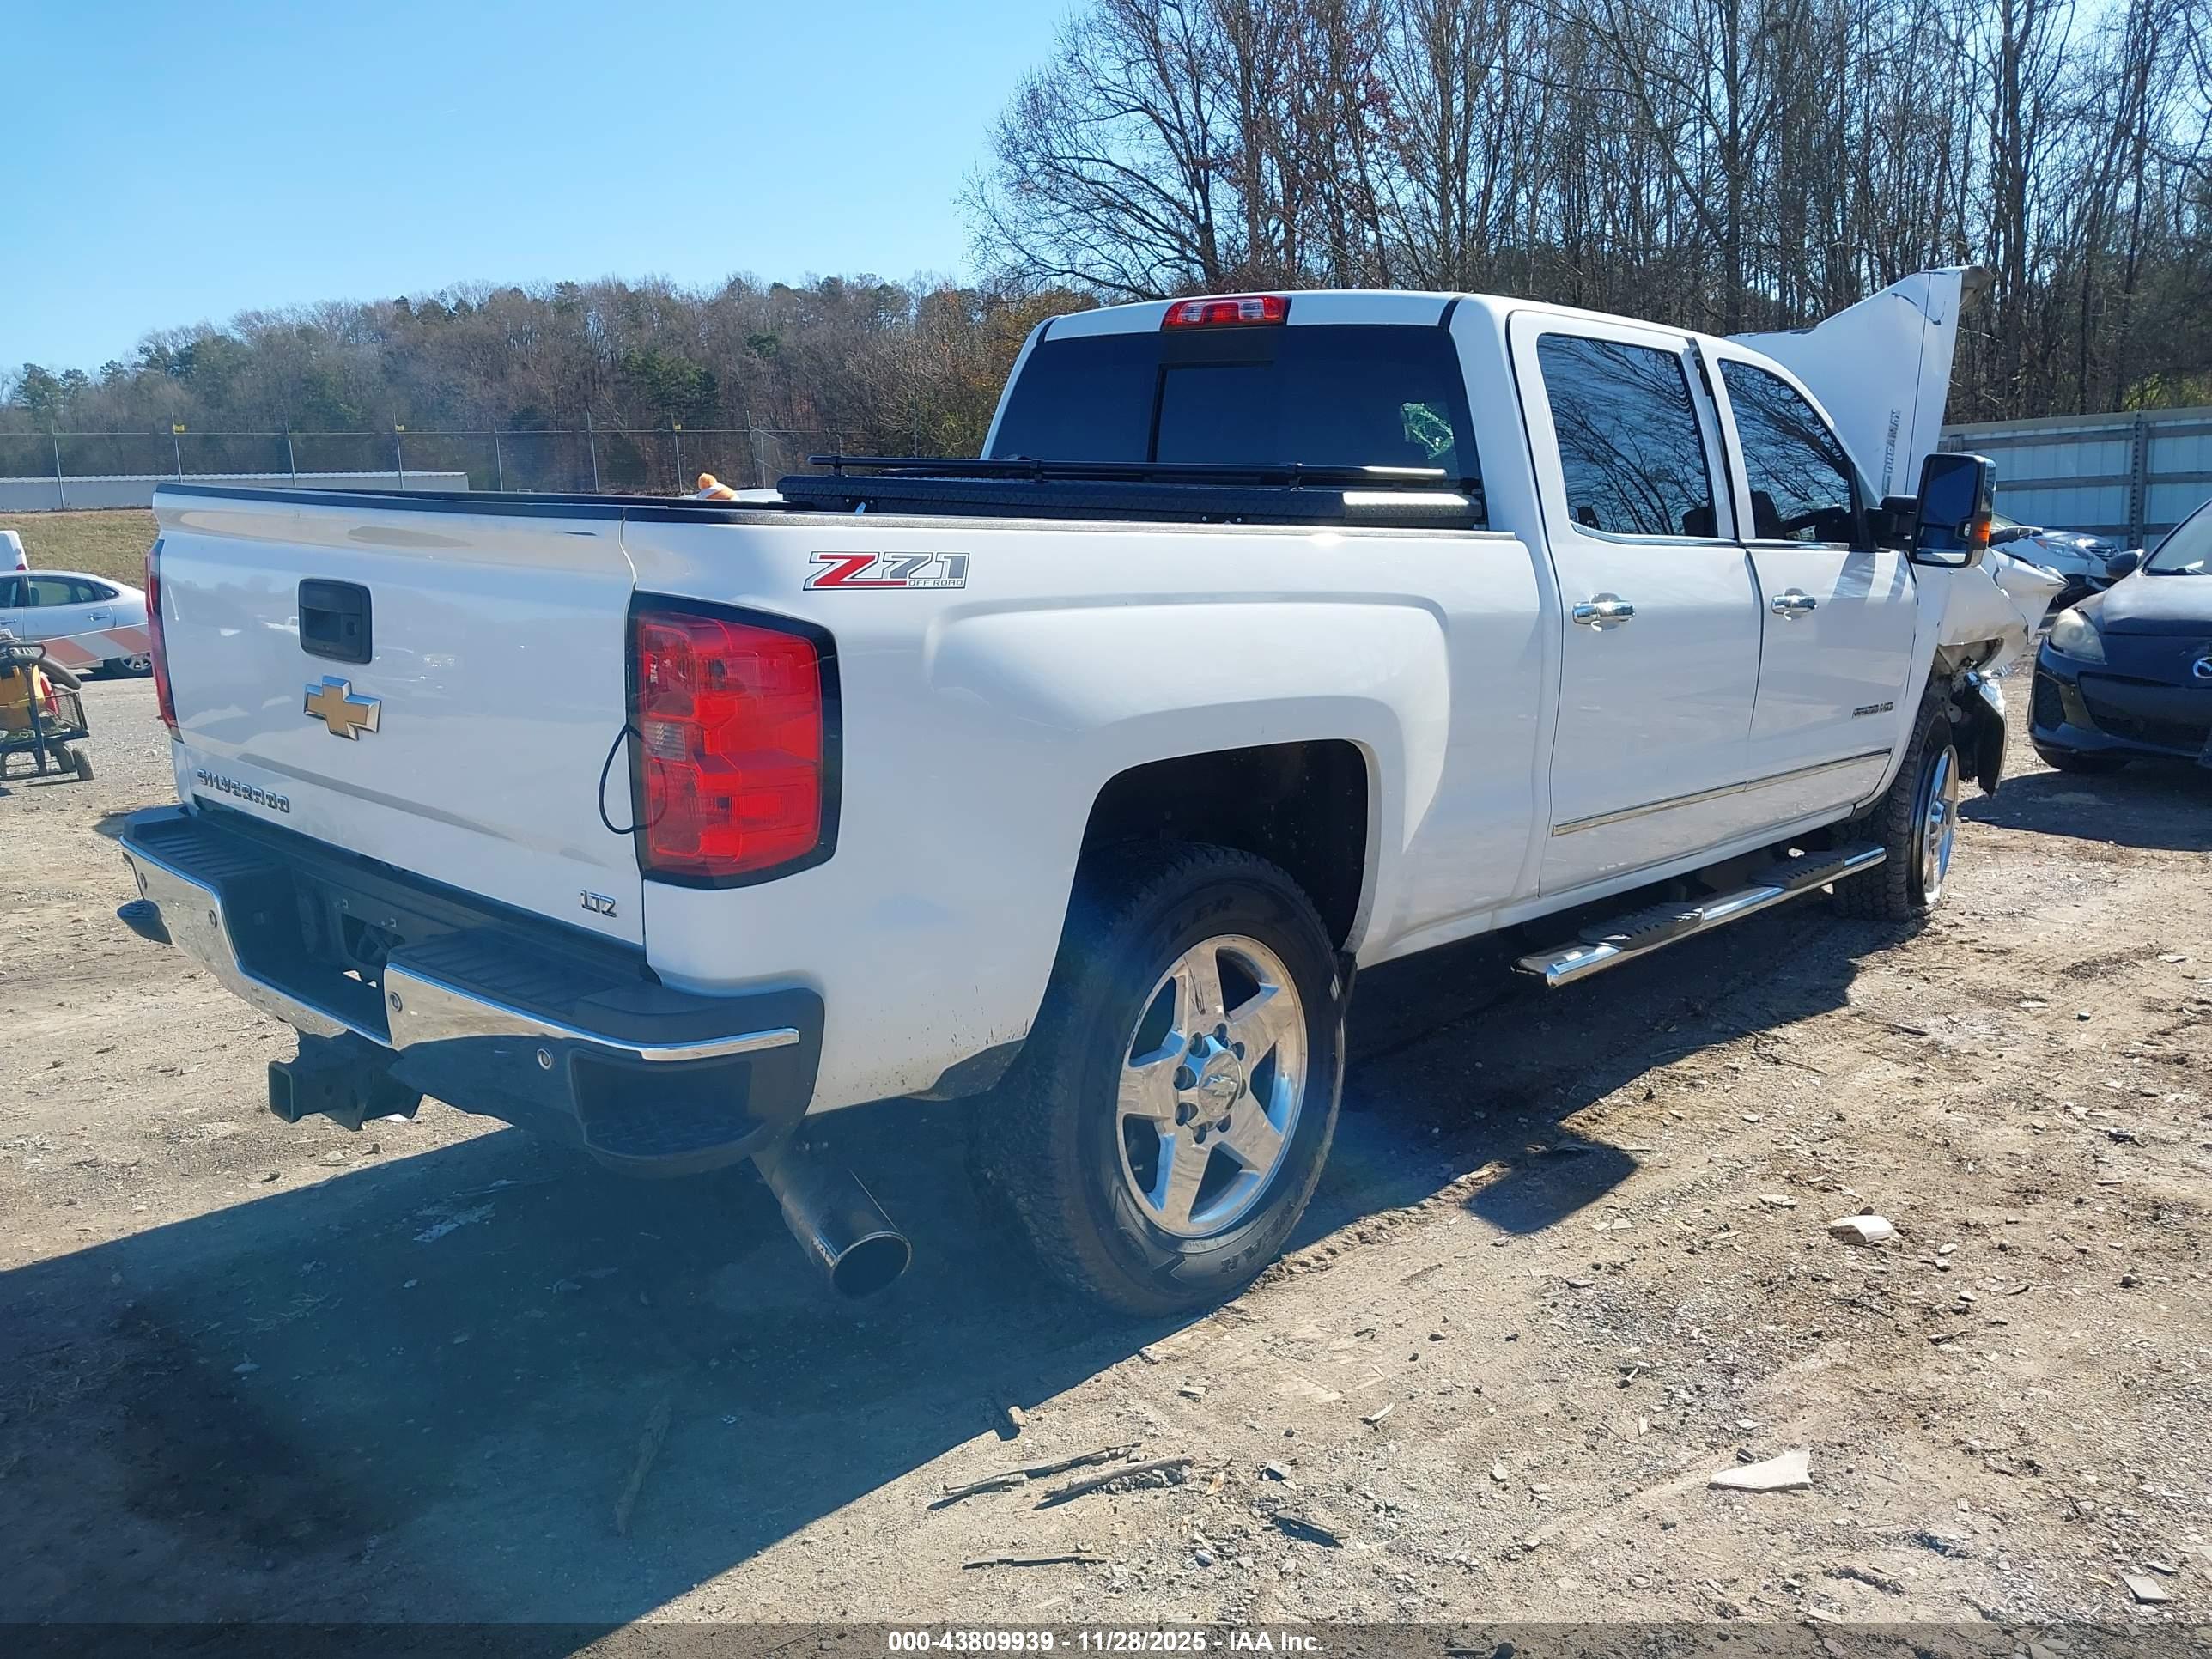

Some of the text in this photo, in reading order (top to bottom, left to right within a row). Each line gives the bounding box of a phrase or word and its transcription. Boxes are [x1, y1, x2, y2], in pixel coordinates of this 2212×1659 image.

[803, 551, 969, 591] Z71
[197, 769, 290, 813] SILVERADO
[580, 890, 617, 918] LTZ
